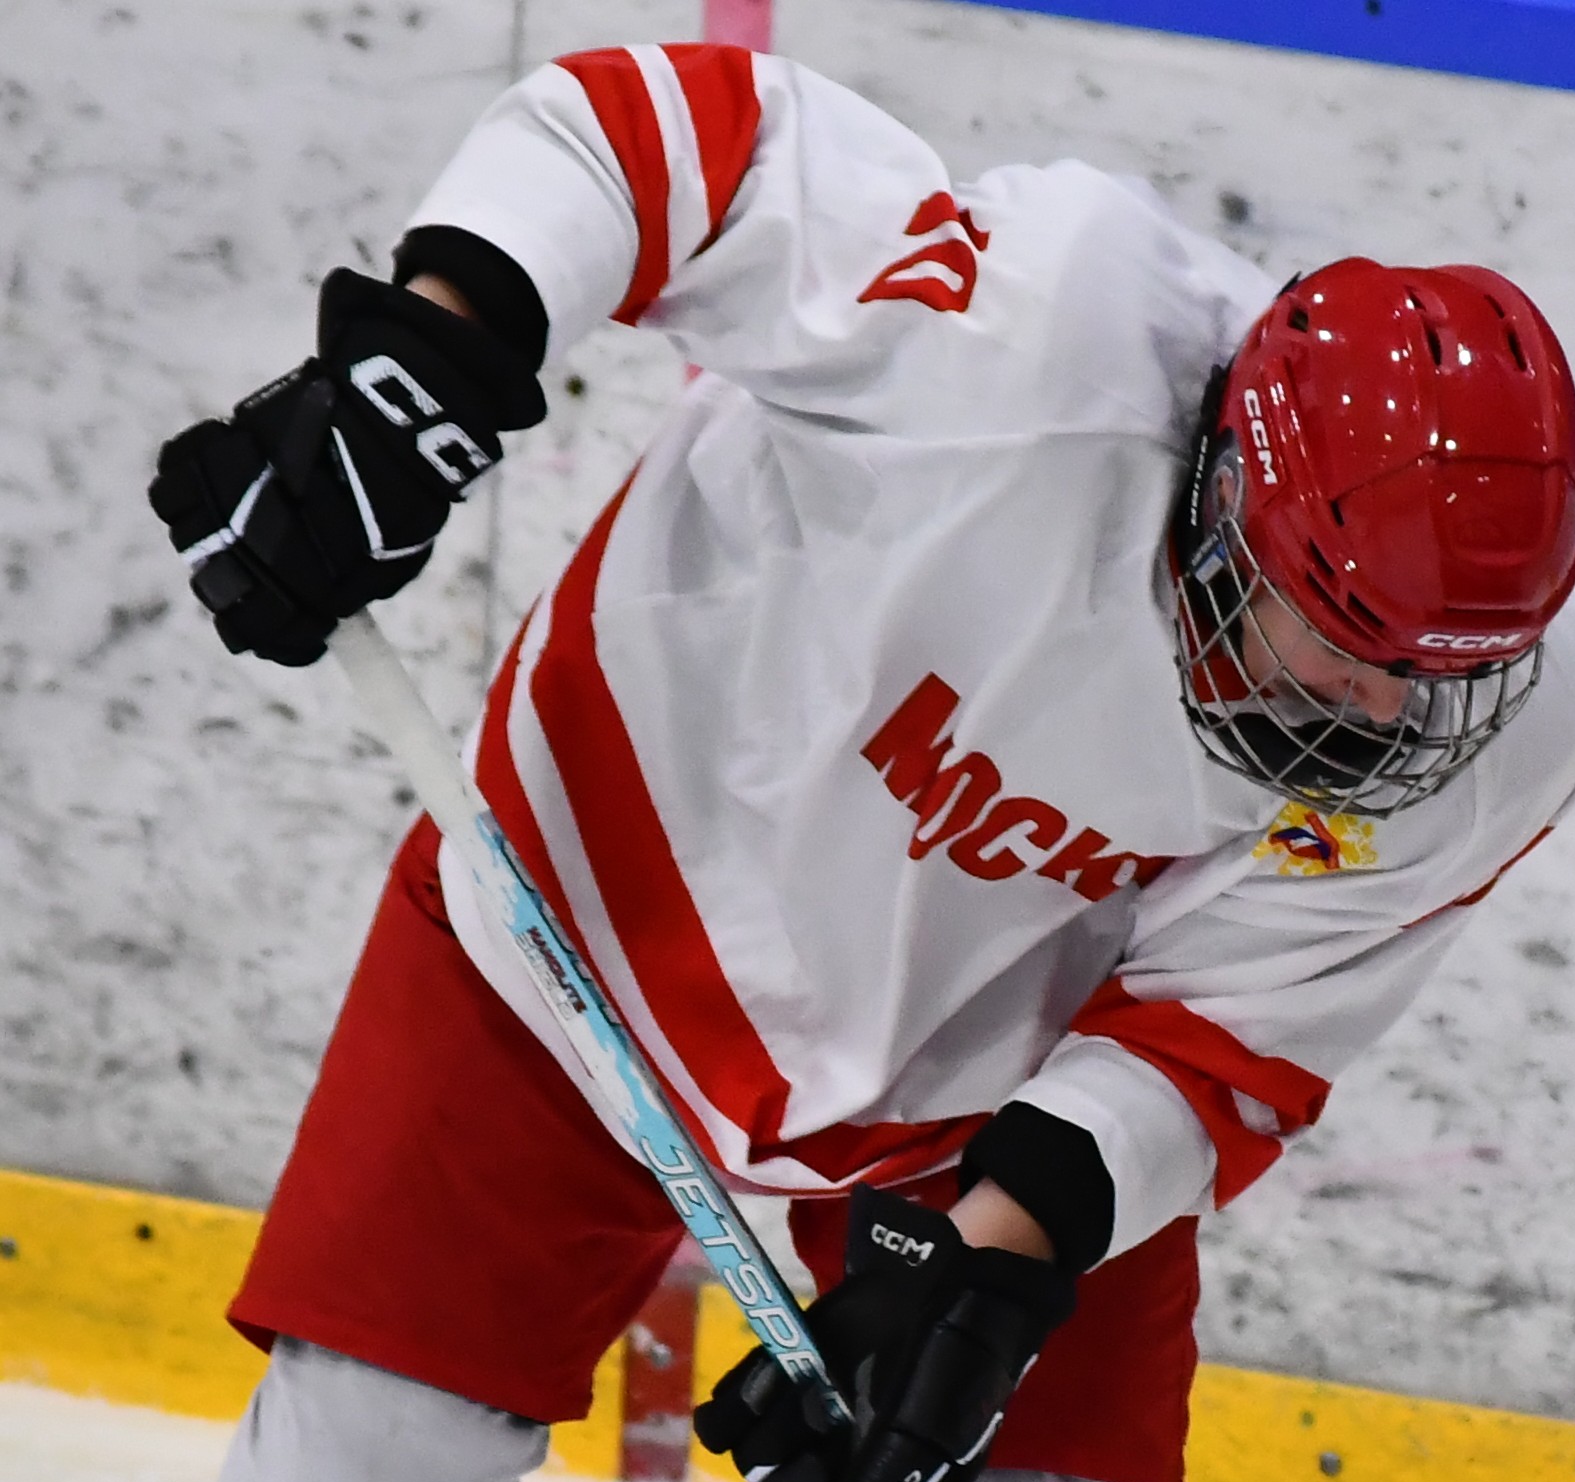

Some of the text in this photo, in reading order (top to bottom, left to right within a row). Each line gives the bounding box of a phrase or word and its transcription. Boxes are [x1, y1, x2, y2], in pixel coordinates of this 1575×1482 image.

[1244, 388, 1278, 485] CCM
[1417, 633, 1522, 649] CCM
[871, 1223, 935, 1261] CCM
[640, 1136, 856, 1424] JETSPE
